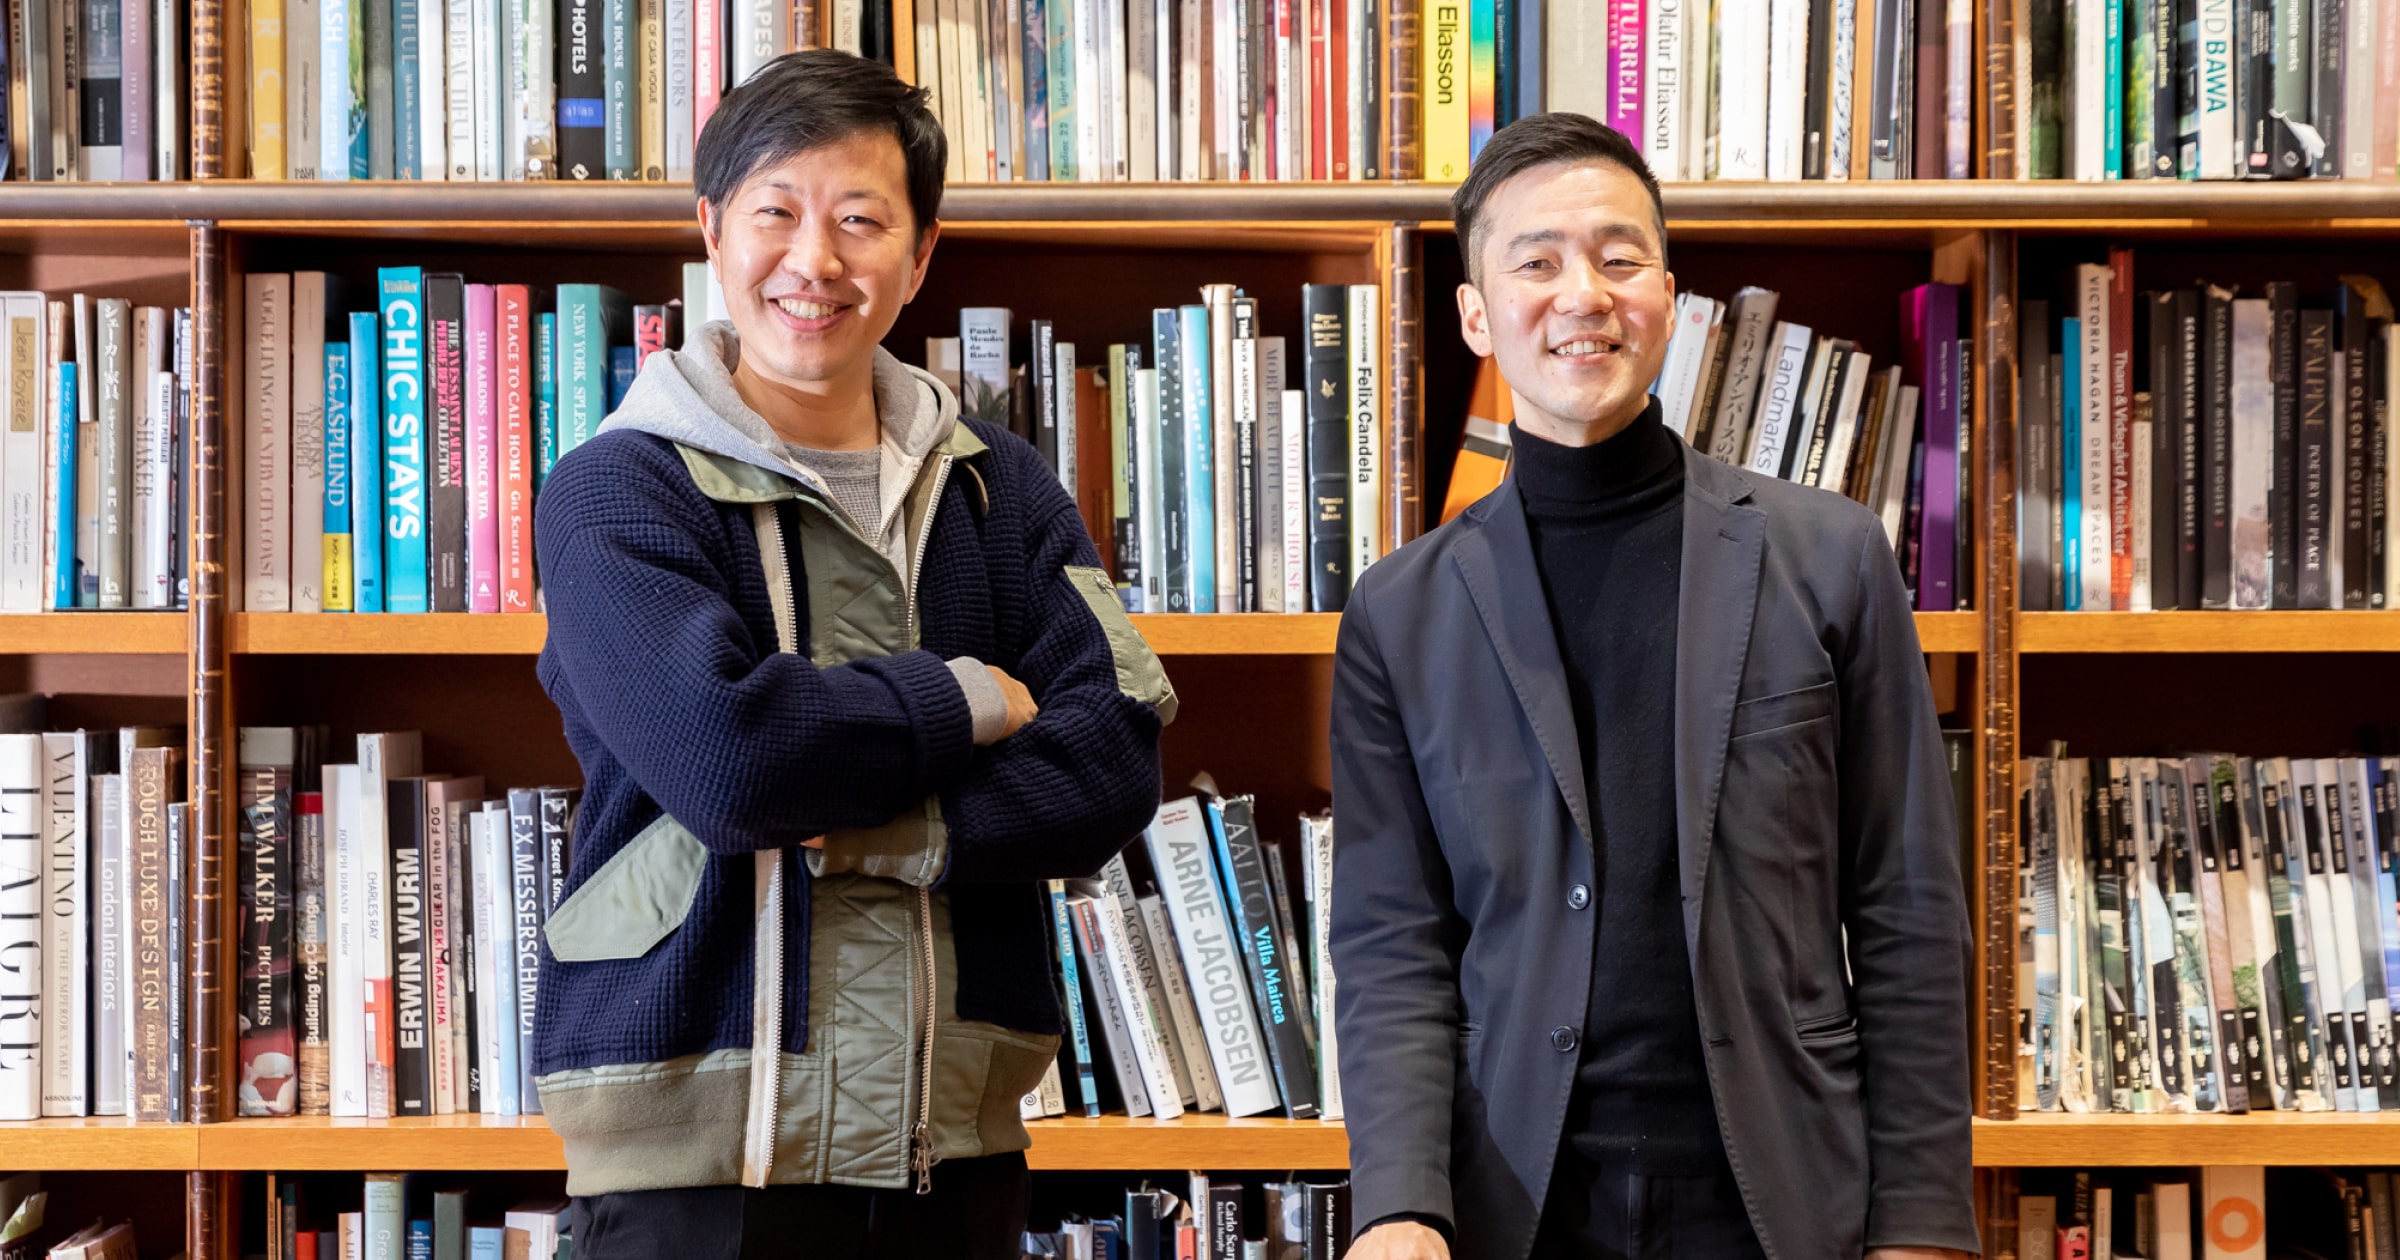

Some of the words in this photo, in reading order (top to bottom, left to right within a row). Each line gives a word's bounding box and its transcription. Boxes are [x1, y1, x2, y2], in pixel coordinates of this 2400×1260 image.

[648, 23, 656, 36] OF
[1656, 0, 1679, 60] Olafur
[2158, 5, 2170, 20] Sri
[2159, 22, 2170, 50] Lanka
[614, 25, 624, 69] HOUSE
[648, 39, 657, 65] CASA
[671, 1, 686, 107] INTERIORS
[1058, 24, 1067, 78] structures
[1437, 6, 1458, 105] Eliasson
[1617, 0, 1640, 119] TURRELL
[2156, 52, 2170, 88] gardens
[2288, 38, 2301, 72] works
[451, 30, 469, 146] BEAUTIFUL
[512, 56, 523, 103] HOME
[649, 69, 657, 104] VOGUE
[1058, 81, 1069, 108] Light
[2206, 40, 2227, 113] BAWA
[1060, 121, 1068, 136] 22
[1656, 67, 1677, 151] Eliasson
[1060, 140, 1069, 176] Zodiac
[259, 288, 275, 344] VOGUE
[507, 300, 518, 311] A
[573, 304, 586, 338] NEW
[1238, 318, 1249, 339] THE
[2089, 276, 2101, 355] VICTORIA
[15, 325, 35, 361] Jean
[386, 299, 417, 400] CHIC
[448, 319, 459, 348] THE
[477, 331, 487, 362] SLIM
[507, 315, 519, 361] PLACE
[969, 327, 997, 335] Paulo
[969, 335, 1005, 343] Mendes
[970, 351, 1001, 359] Rocha
[2214, 307, 2226, 403] SCANDINAVIAN
[2276, 309, 2296, 383] Creating
[260, 347, 275, 402] LIVING
[507, 366, 519, 389] TO
[573, 340, 586, 381] YORK
[1158, 333, 1168, 427] ASPLUND
[1172, 340, 1181, 419] GUNNAR
[1265, 347, 1278, 387] MORE
[1833, 351, 1843, 367] The
[2114, 351, 2128, 395] Tham
[2184, 317, 2195, 418] SCANDINAVIAN
[2350, 347, 2362, 378] JIM
[12, 368, 35, 424] Royère
[478, 364, 488, 416] AARONS
[508, 392, 520, 430] CALL
[1193, 368, 1208, 407] EERO
[1241, 367, 1250, 420] AMERICAN
[1357, 366, 1372, 408] Felix
[1756, 344, 1803, 470] Landmarks
[1817, 368, 1839, 427] Architecture
[2090, 363, 2101, 424] HAGAN
[478, 425, 488, 441] LA
[1187, 394, 1209, 472] SAARINEN
[1240, 421, 1251, 455] HOUSE
[2214, 407, 2226, 461] MODERN
[2282, 388, 2296, 441] Home
[2350, 385, 2362, 450] OLSON
[136, 416, 155, 498] SHAKER
[296, 411, 309, 471] HEMPEL
[308, 403, 322, 480] ANOUSKA
[438, 408, 450, 488] COLLECTION
[449, 426, 462, 488] LAURENT
[478, 443, 489, 487] DOLCE
[508, 433, 520, 481] HOME
[1241, 457, 1250, 465] 3
[1266, 400, 1280, 494] BEAUTIFUL
[1358, 410, 1373, 483] Candela
[1808, 437, 1826, 471] PAUL
[2112, 407, 2128, 476] Videgård
[2184, 424, 2195, 480] MODERN
[387, 413, 421, 539] STAYS
[1286, 433, 1299, 527] MOTHER'S
[2090, 438, 2101, 496] DREAM
[2214, 466, 2225, 515] HOUSES
[2307, 445, 2320, 498] POETRY
[478, 490, 489, 520] VITA
[2113, 478, 2128, 556] Arkitekter
[2184, 486, 2195, 537] HOUSES
[2307, 503, 2320, 522] OF
[2350, 456, 2362, 530] HOUSES
[2375, 473, 2384, 518] HOUSES
[259, 530, 275, 580] COAST
[2090, 504, 2102, 565] SPACES
[2307, 527, 2321, 571] PLACE
[1270, 546, 1279, 580] SIKES
[1287, 533, 1300, 593] HOUSE
[139, 767, 158, 843] ROUGH
[254, 767, 276, 813] TIM
[52, 751, 76, 918] VALENTINO
[431, 806, 442, 835] FOG
[514, 815, 533, 852] F.X.
[254, 820, 276, 924] WALKER
[338, 829, 350, 869] JOSEPH
[431, 839, 441, 860] the
[432, 865, 442, 877] in
[551, 838, 563, 875] Secret
[1226, 822, 1270, 919] AALTO
[101, 857, 118, 929] London
[140, 850, 159, 912] LUXE
[366, 871, 379, 908] CHARLES
[395, 847, 421, 944] WURM
[476, 873, 488, 900] RON
[0, 786, 42, 1071] LIAIGRE
[58, 929, 69, 945] AT
[305, 895, 320, 955] Change
[340, 923, 350, 956] Interior
[367, 912, 379, 940] RAY
[478, 903, 489, 947] MUECK
[1122, 907, 1158, 991] JACOBSEN
[1253, 925, 1277, 968] Villa
[58, 948, 69, 971] THE
[102, 933, 119, 1011] Interiors
[141, 918, 160, 1012] DESIGN
[306, 958, 320, 981] for
[1168, 840, 1216, 924] ARNE
[1192, 925, 1261, 1088] JACOBSEN
[58, 976, 70, 1040] EMPEROR'S
[257, 946, 272, 1026] PICTURES
[398, 952, 424, 1048] ERWIN
[1259, 969, 1287, 1026] Mairea
[305, 984, 321, 1046] Building
[58, 1044, 69, 1081] TABLE
[146, 1058, 155, 1081] LEE
[44, 1094, 83, 1102] ASSOULINE
[1216, 1201, 1224, 1225] Richard
[1226, 1201, 1238, 1232] Carlo
[1326, 1194, 1334, 1211] Carlo
[1215, 1227, 1225, 1252] Murphy
